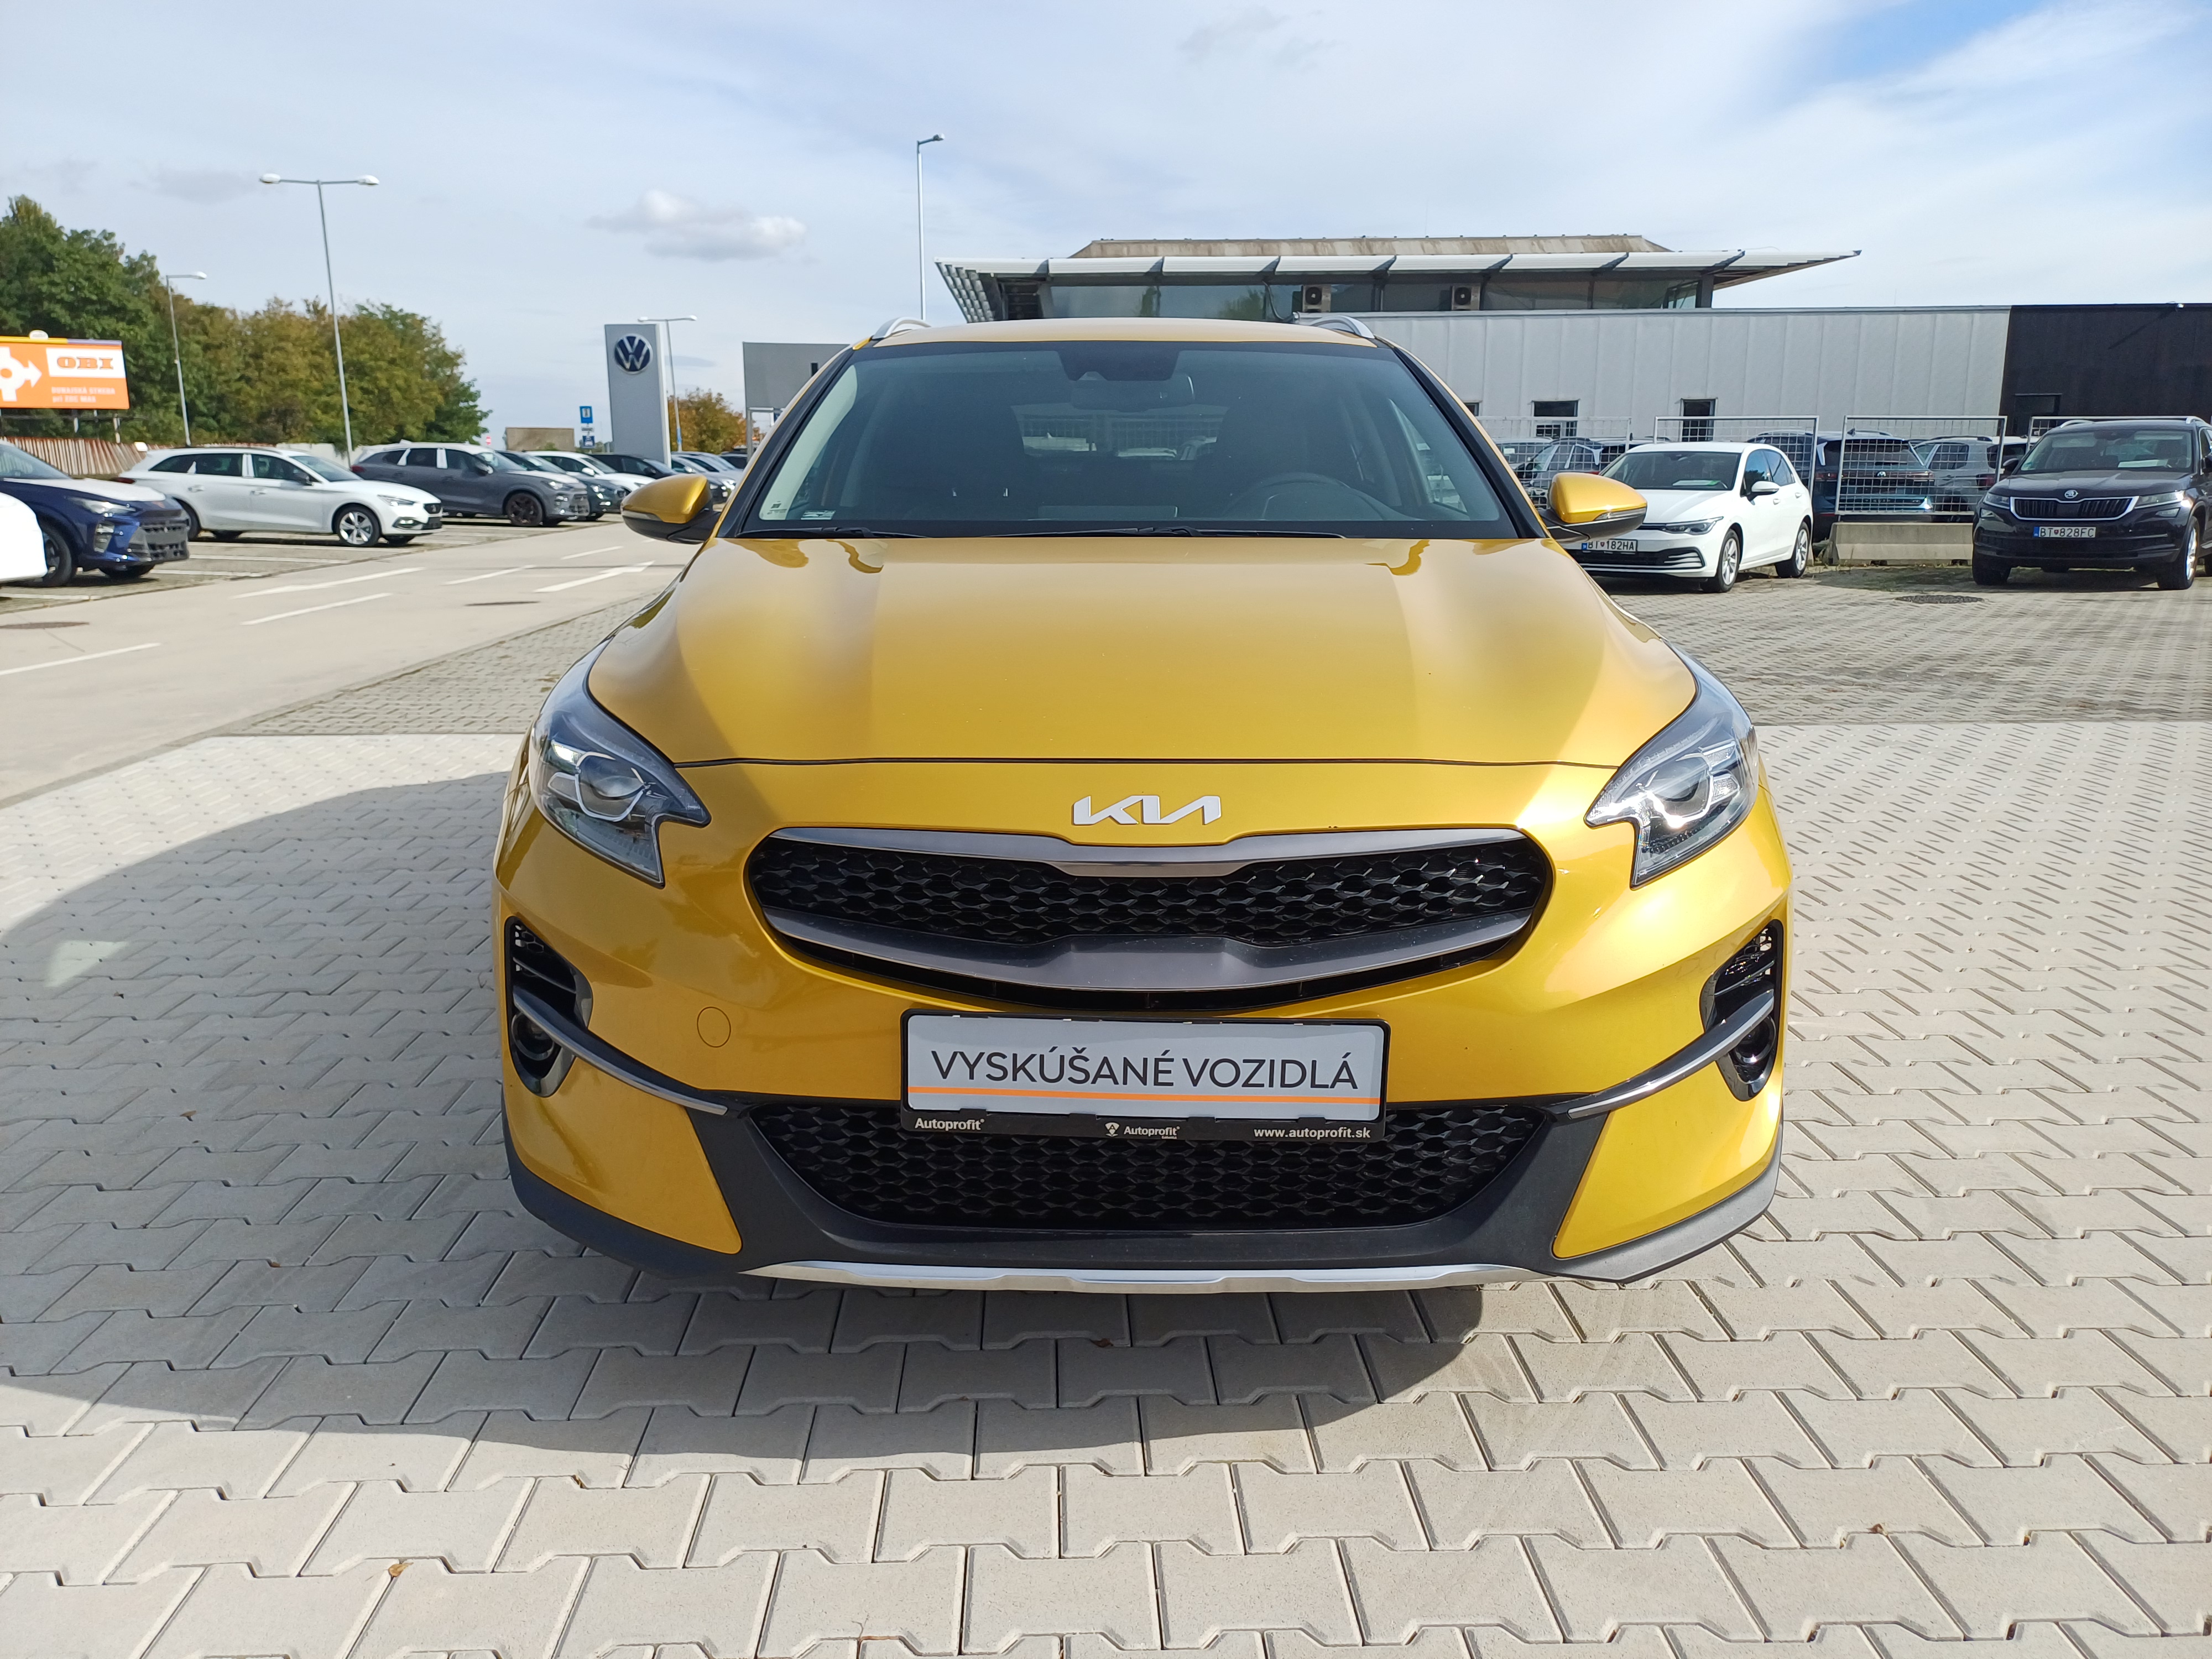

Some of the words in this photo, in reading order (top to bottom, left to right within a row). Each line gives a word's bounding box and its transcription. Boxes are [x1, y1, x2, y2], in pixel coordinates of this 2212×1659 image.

[56, 357, 113, 369] OBI
[1072, 795, 1222, 825] KIA
[931, 1046, 1174, 1087] VYSKÚŠANÉ
[1182, 1052, 1358, 1089] VOZIDLÁ
[1254, 1126, 1371, 1140] www.autoprofit.sk
